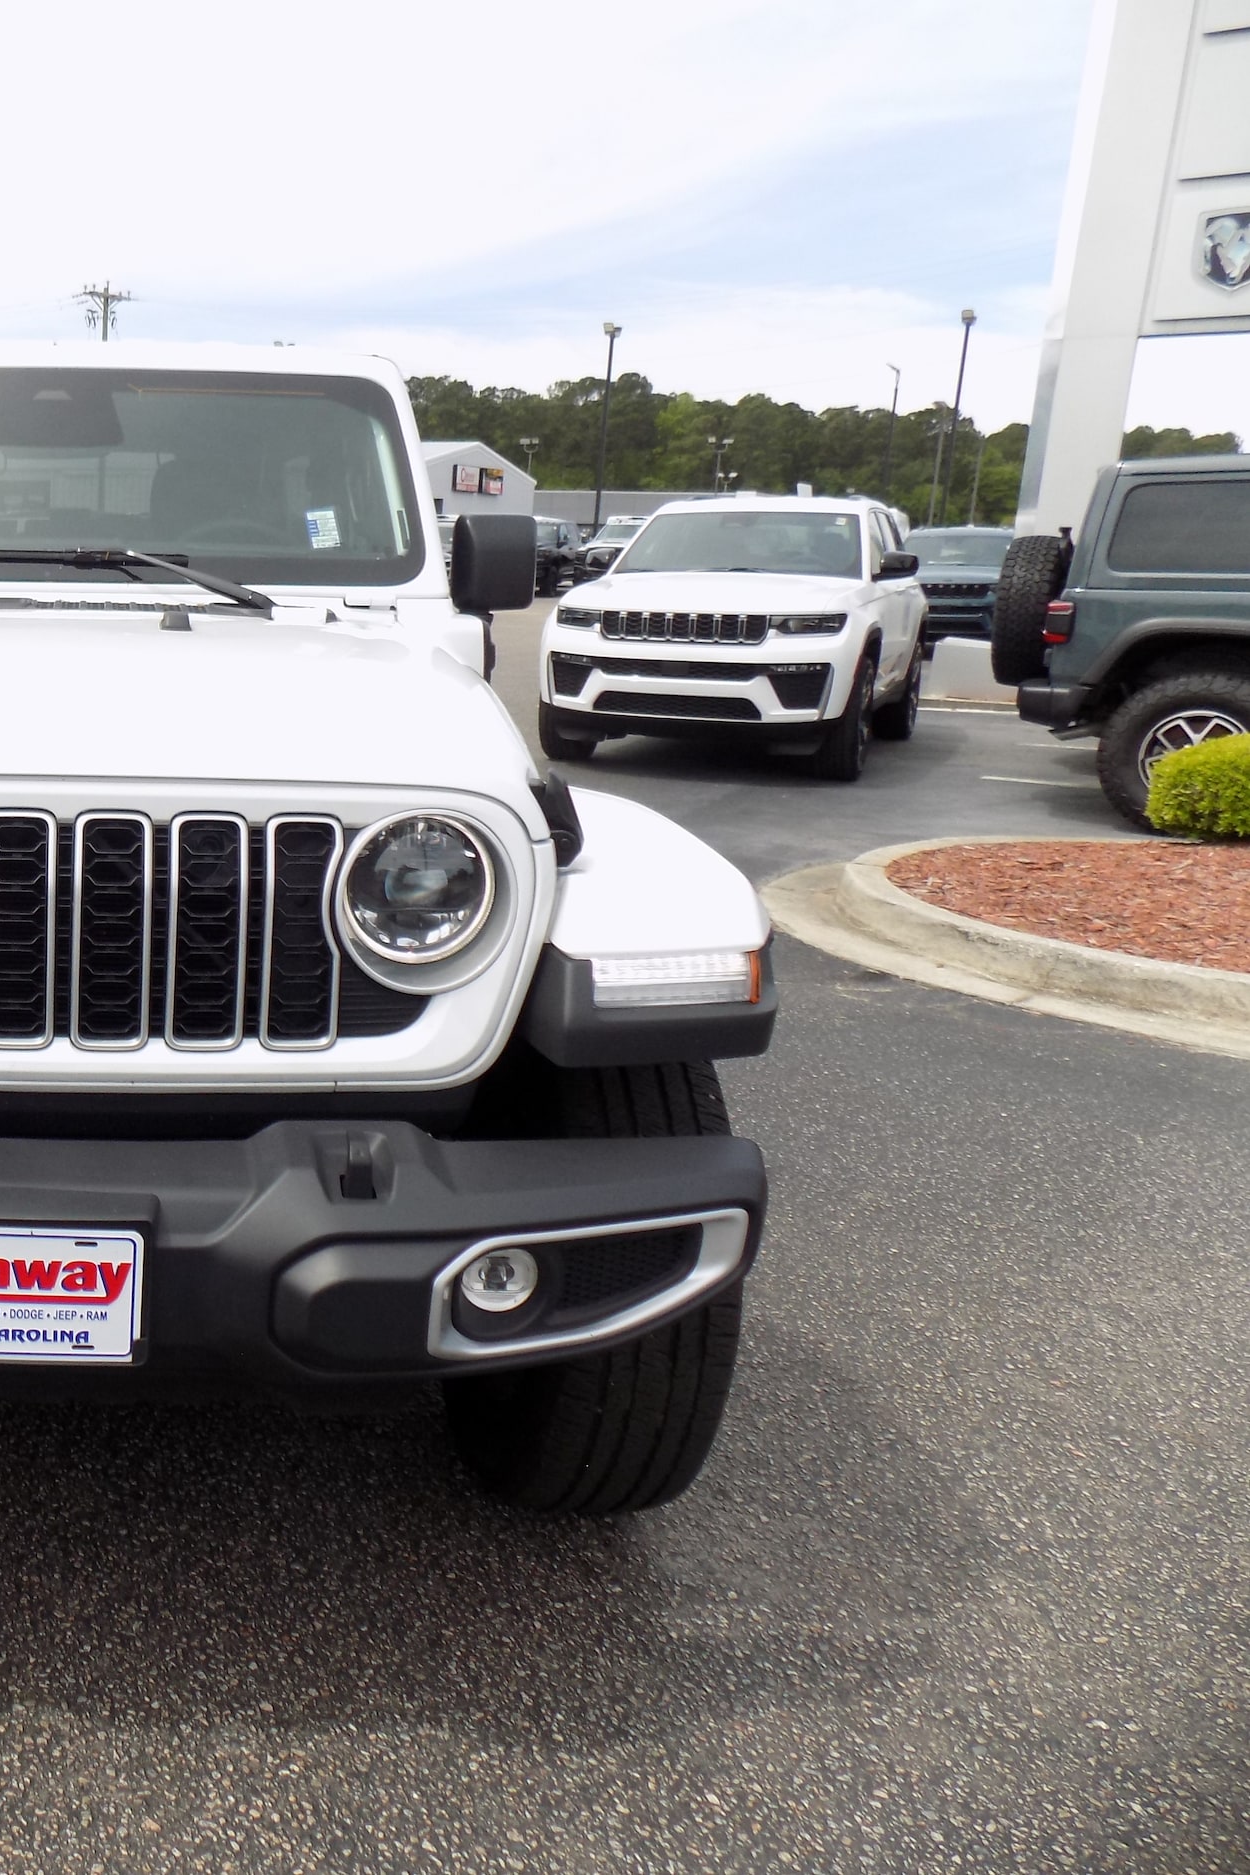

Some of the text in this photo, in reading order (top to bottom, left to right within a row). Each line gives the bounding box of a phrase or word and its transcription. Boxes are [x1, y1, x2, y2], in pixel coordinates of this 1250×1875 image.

[9, 1309, 44, 1320] DODGE
[53, 1310, 77, 1321] JEEP
[86, 1311, 108, 1321] RAM
